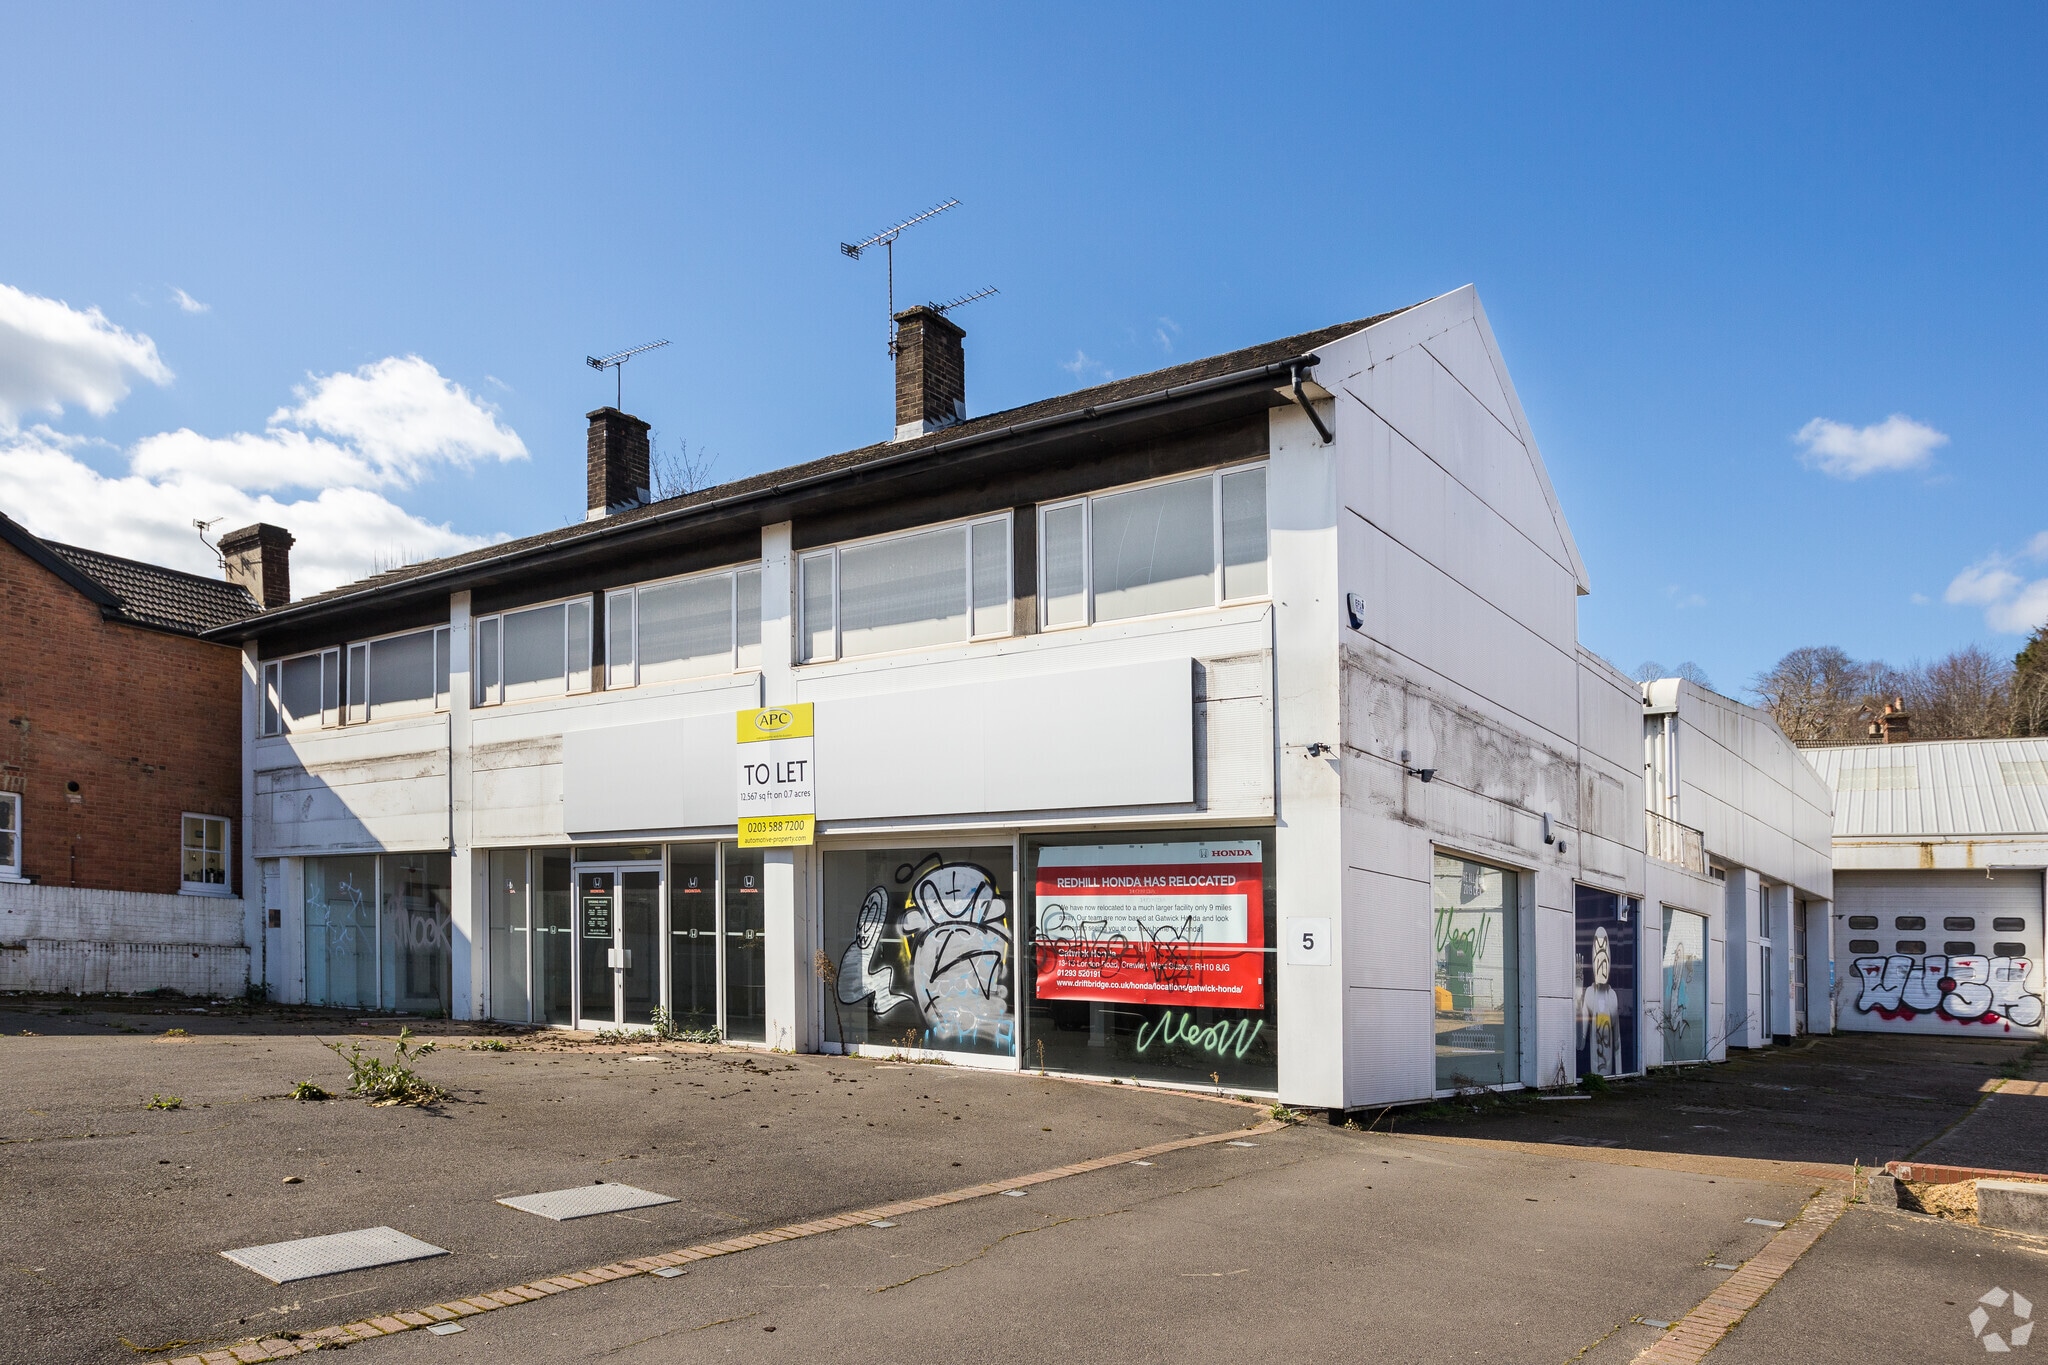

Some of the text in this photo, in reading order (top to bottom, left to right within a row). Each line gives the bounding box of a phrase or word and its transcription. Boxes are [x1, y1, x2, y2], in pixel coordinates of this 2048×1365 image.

[759, 713, 788, 726] APC
[744, 760, 807, 785] TO LET
[758, 793, 766, 802] sq
[767, 790, 773, 799] ft
[784, 790, 792, 798] 0.7
[794, 789, 811, 798] acres
[748, 820, 804, 832] 0203 588 7200
[745, 835, 806, 844] automotive-property.com
[1212, 849, 1253, 857] HONDA
[1057, 875, 1236, 888] REDHILL HONDA HAS RELOCATED
[1156, 904, 1173, 912] larger
[1175, 904, 1193, 912] facility
[1302, 932, 1314, 950] 5
[1058, 949, 1088, 957] Gatwik
[1150, 962, 1167, 970] Wet
[1056, 980, 1243, 993] www.driftbridge.co.uk/honda/locations/gatwick-honda/
